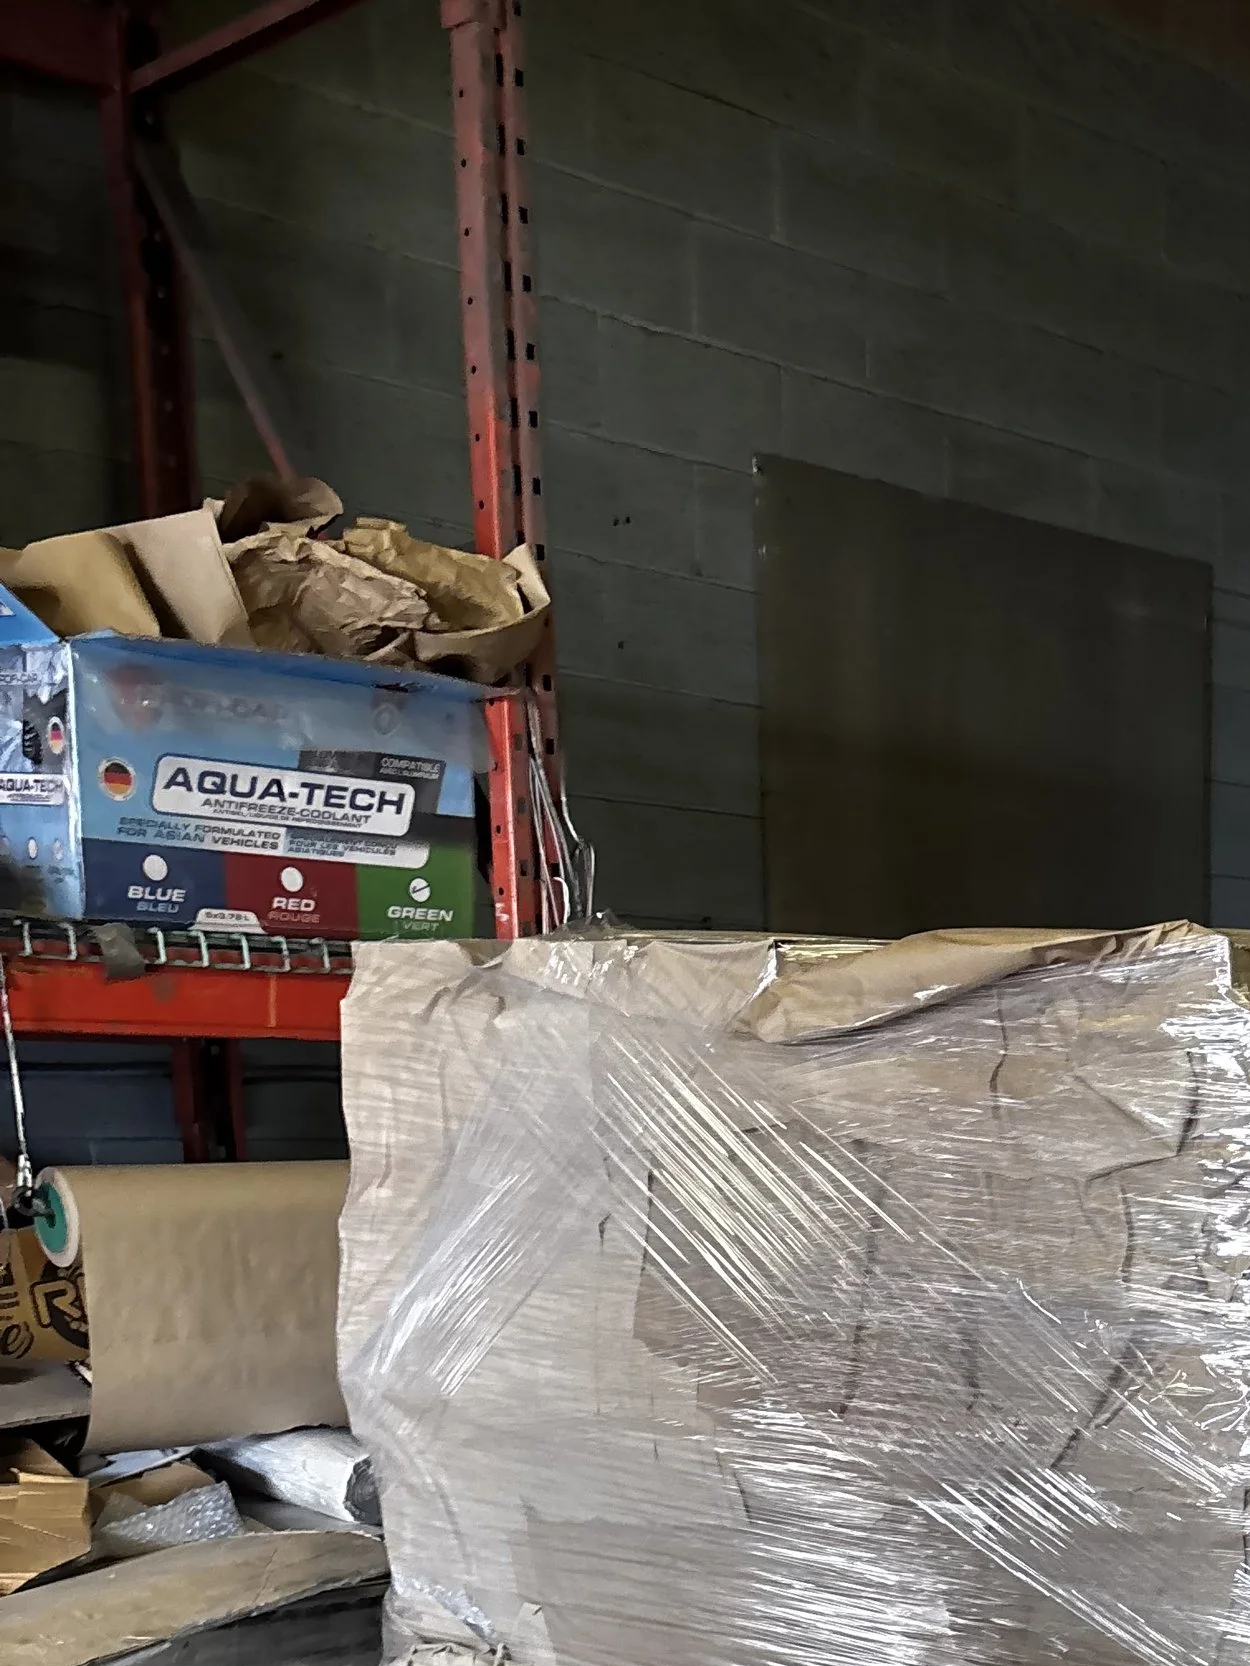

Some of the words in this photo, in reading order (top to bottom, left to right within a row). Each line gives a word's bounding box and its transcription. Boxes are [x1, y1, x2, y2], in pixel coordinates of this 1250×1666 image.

[381, 757, 441, 773] COMPATIBLE
[162, 766, 406, 815] AQUA-TECH
[202, 798, 372, 824] ANTIFREEZE-COOLANT
[119, 816, 191, 832] SPECIALLY
[195, 823, 281, 841] FORMULATED
[117, 826, 148, 838] FOR
[154, 831, 205, 843] ASIAN
[212, 835, 279, 851] VEHICLES
[127, 885, 187, 903] BLUE
[136, 901, 180, 914] BLEU
[272, 896, 316, 912] RED
[267, 910, 321, 924] ROUGE
[387, 905, 454, 922] GREEN
[403, 920, 440, 933] VERT
